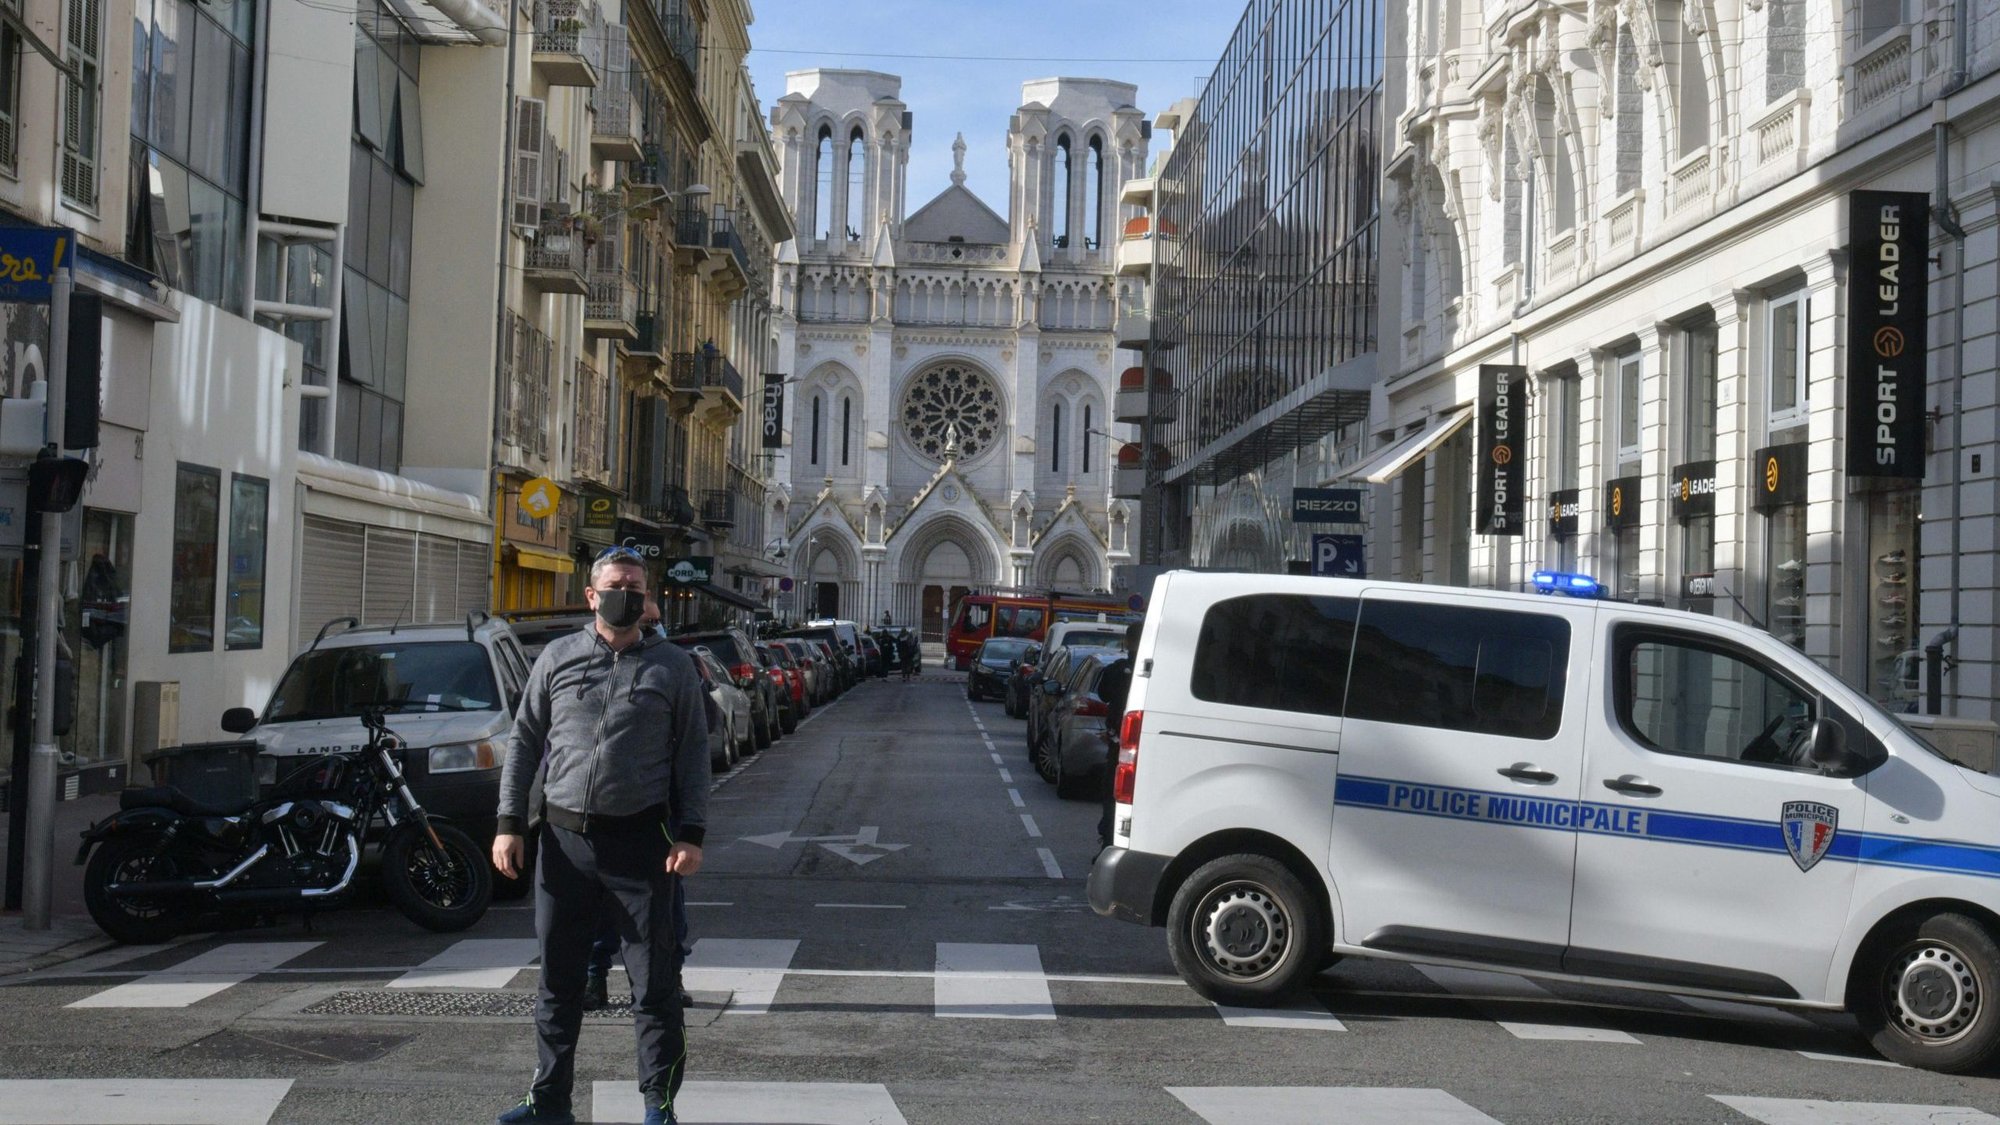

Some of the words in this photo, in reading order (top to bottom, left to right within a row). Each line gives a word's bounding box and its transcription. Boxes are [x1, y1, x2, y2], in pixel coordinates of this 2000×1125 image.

[1879, 205, 1900, 316] LEADER
[764, 382, 783, 437] fnac
[1496, 372, 1509, 440] LEADER
[1877, 365, 1898, 465] SPORT
[1494, 468, 1507, 528] SPORT
[1689, 478, 1715, 495] LEADE
[1296, 500, 1358, 511] REZZO
[1560, 503, 1578, 517] LEADE
[1318, 543, 1337, 572] P
[297, 746, 342, 754] LAND
[1393, 786, 1480, 817] POLICE
[1487, 799, 1642, 834] MUNICIPALE
[1785, 803, 1835, 818] POLICE
[1785, 813, 1834, 825] MUNICIPALE
